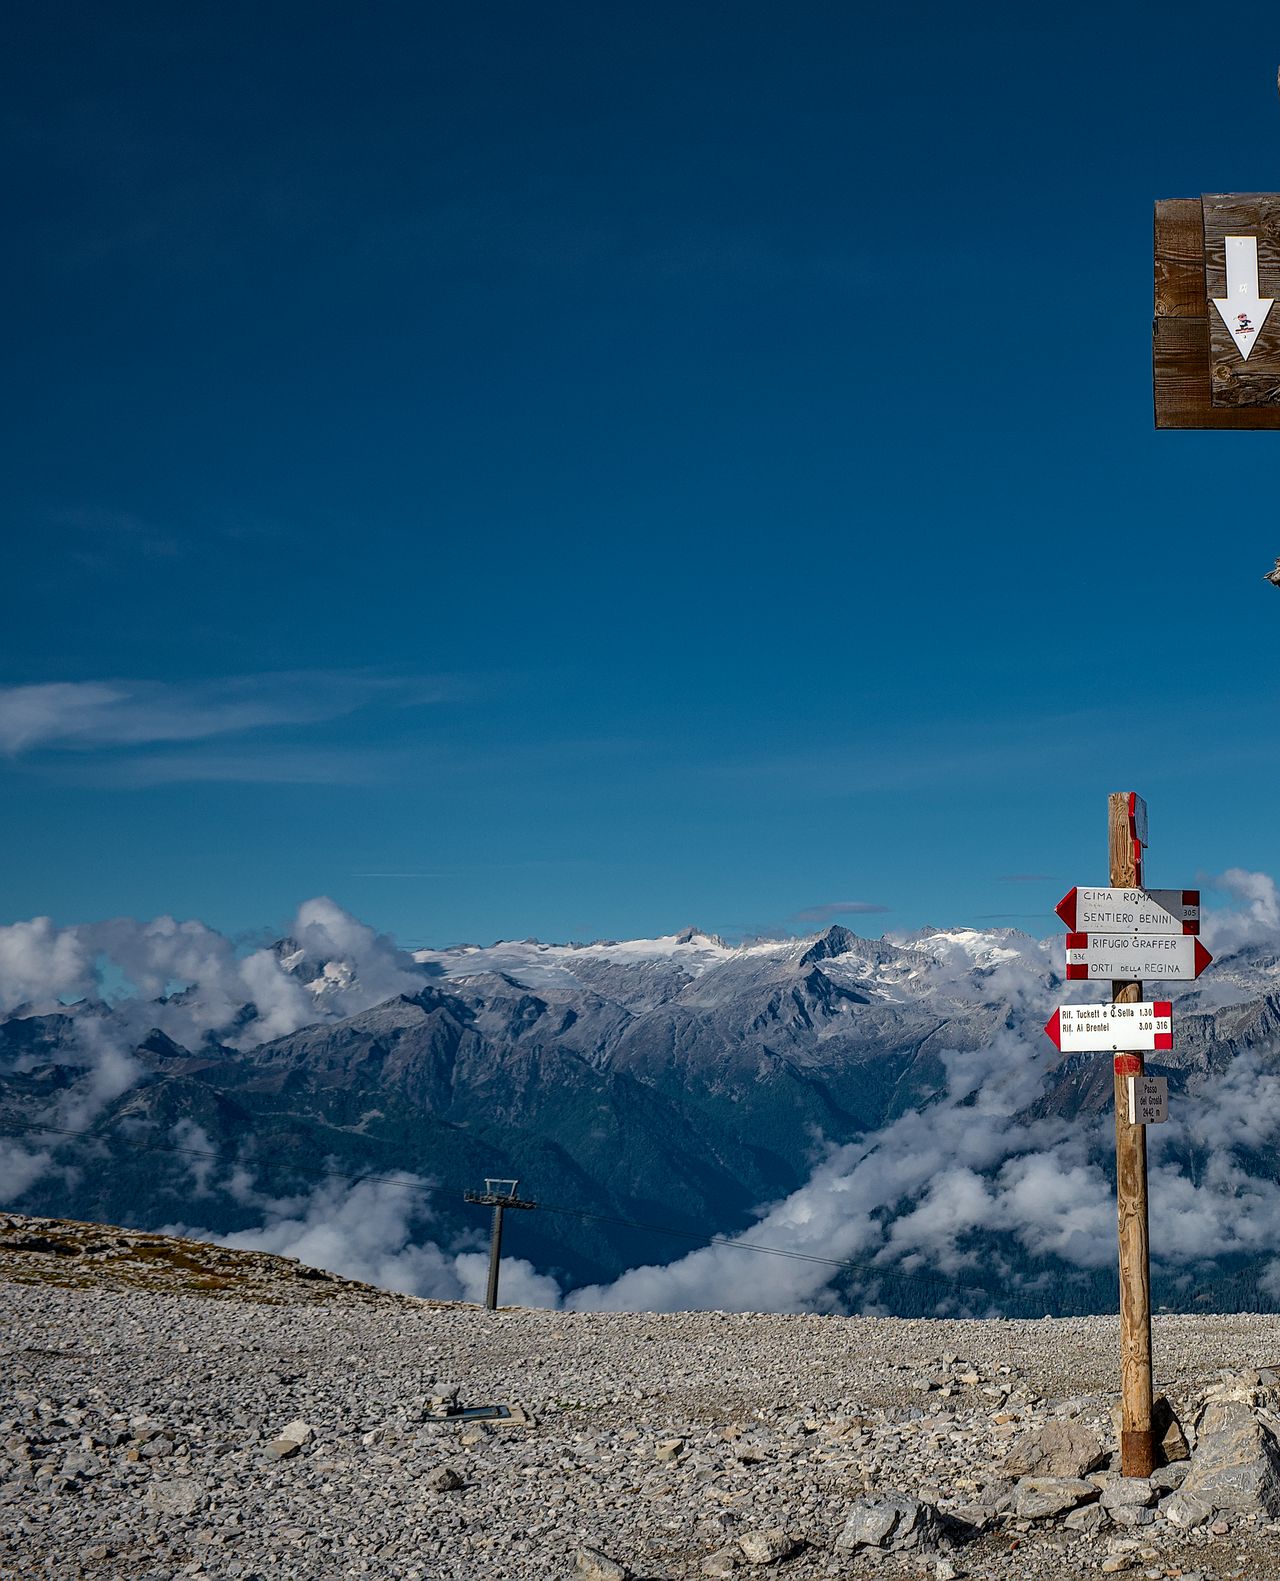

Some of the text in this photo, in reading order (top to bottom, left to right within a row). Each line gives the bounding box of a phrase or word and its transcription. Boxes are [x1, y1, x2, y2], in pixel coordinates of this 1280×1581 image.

[1083, 891, 1152, 902] CIMA ROMA
[1083, 912, 1172, 924] SENTIERO BENINI
[1183, 909, 1197, 917] 305
[1092, 938, 1177, 949] RIFUGIO GRAFFER
[1091, 963, 1113, 973] ORTI
[1144, 963, 1180, 973] REGINA
[1062, 1010, 1073, 1019] Rif.
[1076, 1009, 1099, 1019] Tuckett
[1103, 1010, 1107, 1018] e
[1139, 1008, 1153, 1017] 1.30
[1062, 1023, 1073, 1032] Rif.
[1138, 1021, 1153, 1031] 3.00
[1156, 1020, 1168, 1030] 316
